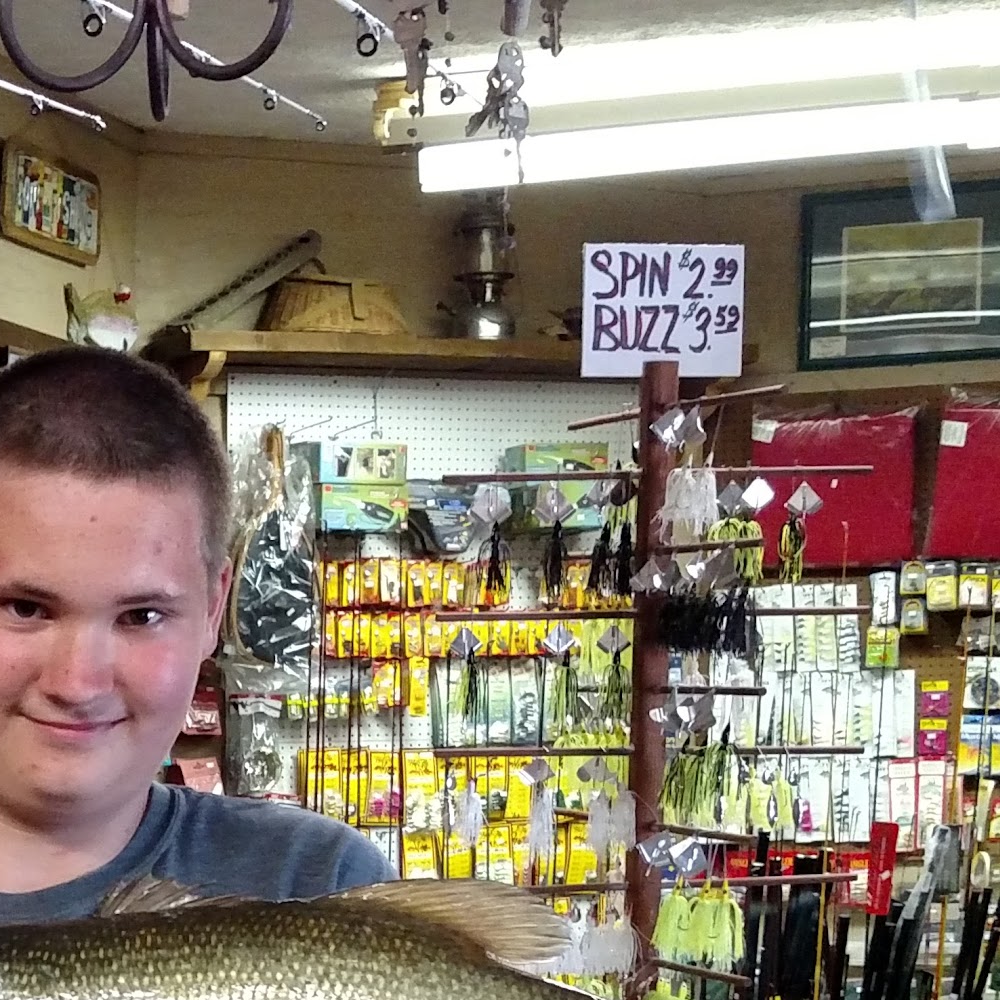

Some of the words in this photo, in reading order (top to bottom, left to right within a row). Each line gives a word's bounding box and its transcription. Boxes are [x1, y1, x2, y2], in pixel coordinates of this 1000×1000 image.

[590, 249, 671, 300] SPIN
[678, 248, 739, 300] $2.99
[592, 303, 682, 354] BUZZ
[682, 301, 741, 354] $3.59
